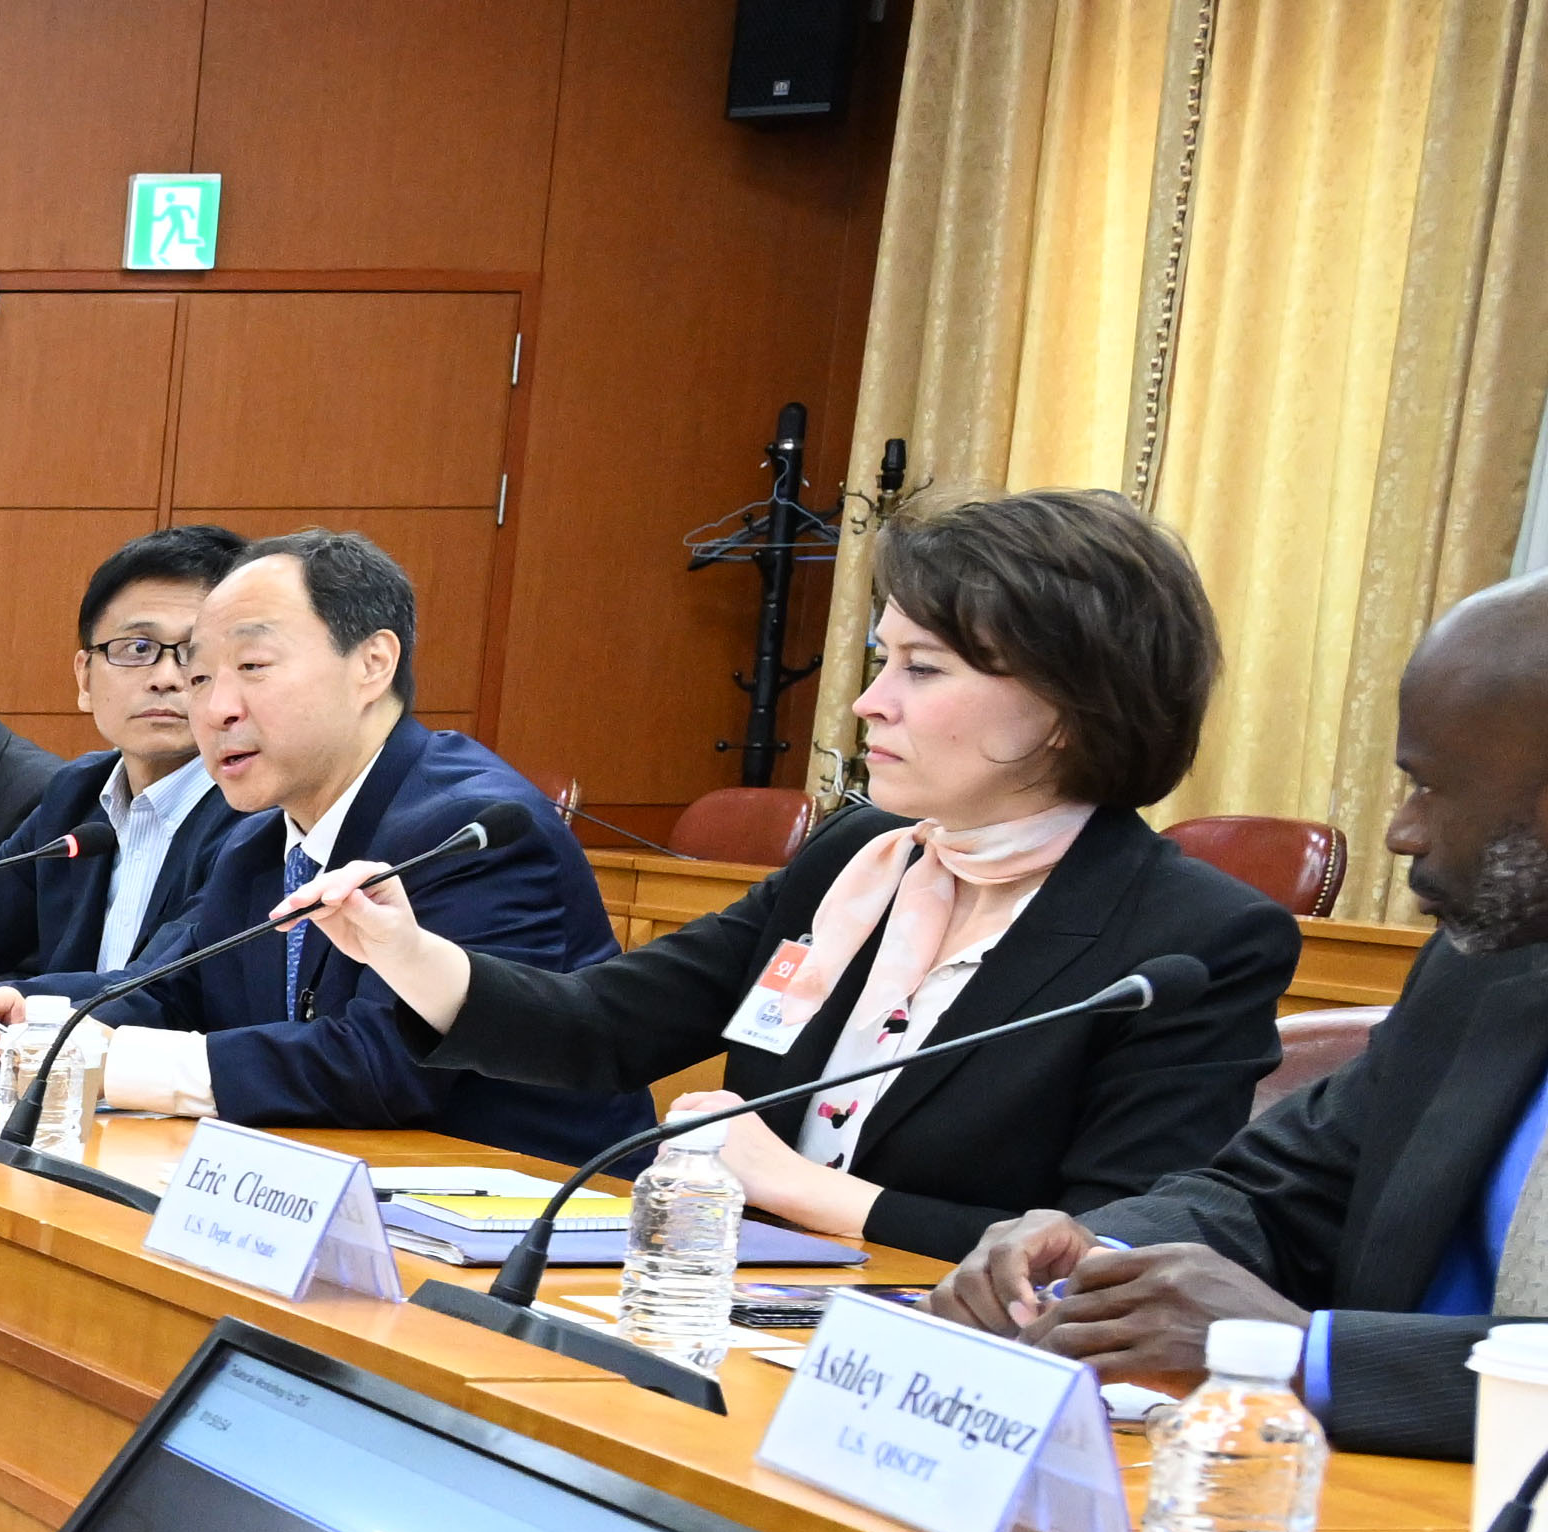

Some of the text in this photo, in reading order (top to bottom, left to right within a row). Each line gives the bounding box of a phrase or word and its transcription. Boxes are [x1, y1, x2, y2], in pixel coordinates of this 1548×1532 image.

[186, 1157, 319, 1223] Eric Clemons
[805, 1343, 1038, 1455] Ashley Rodriguez
